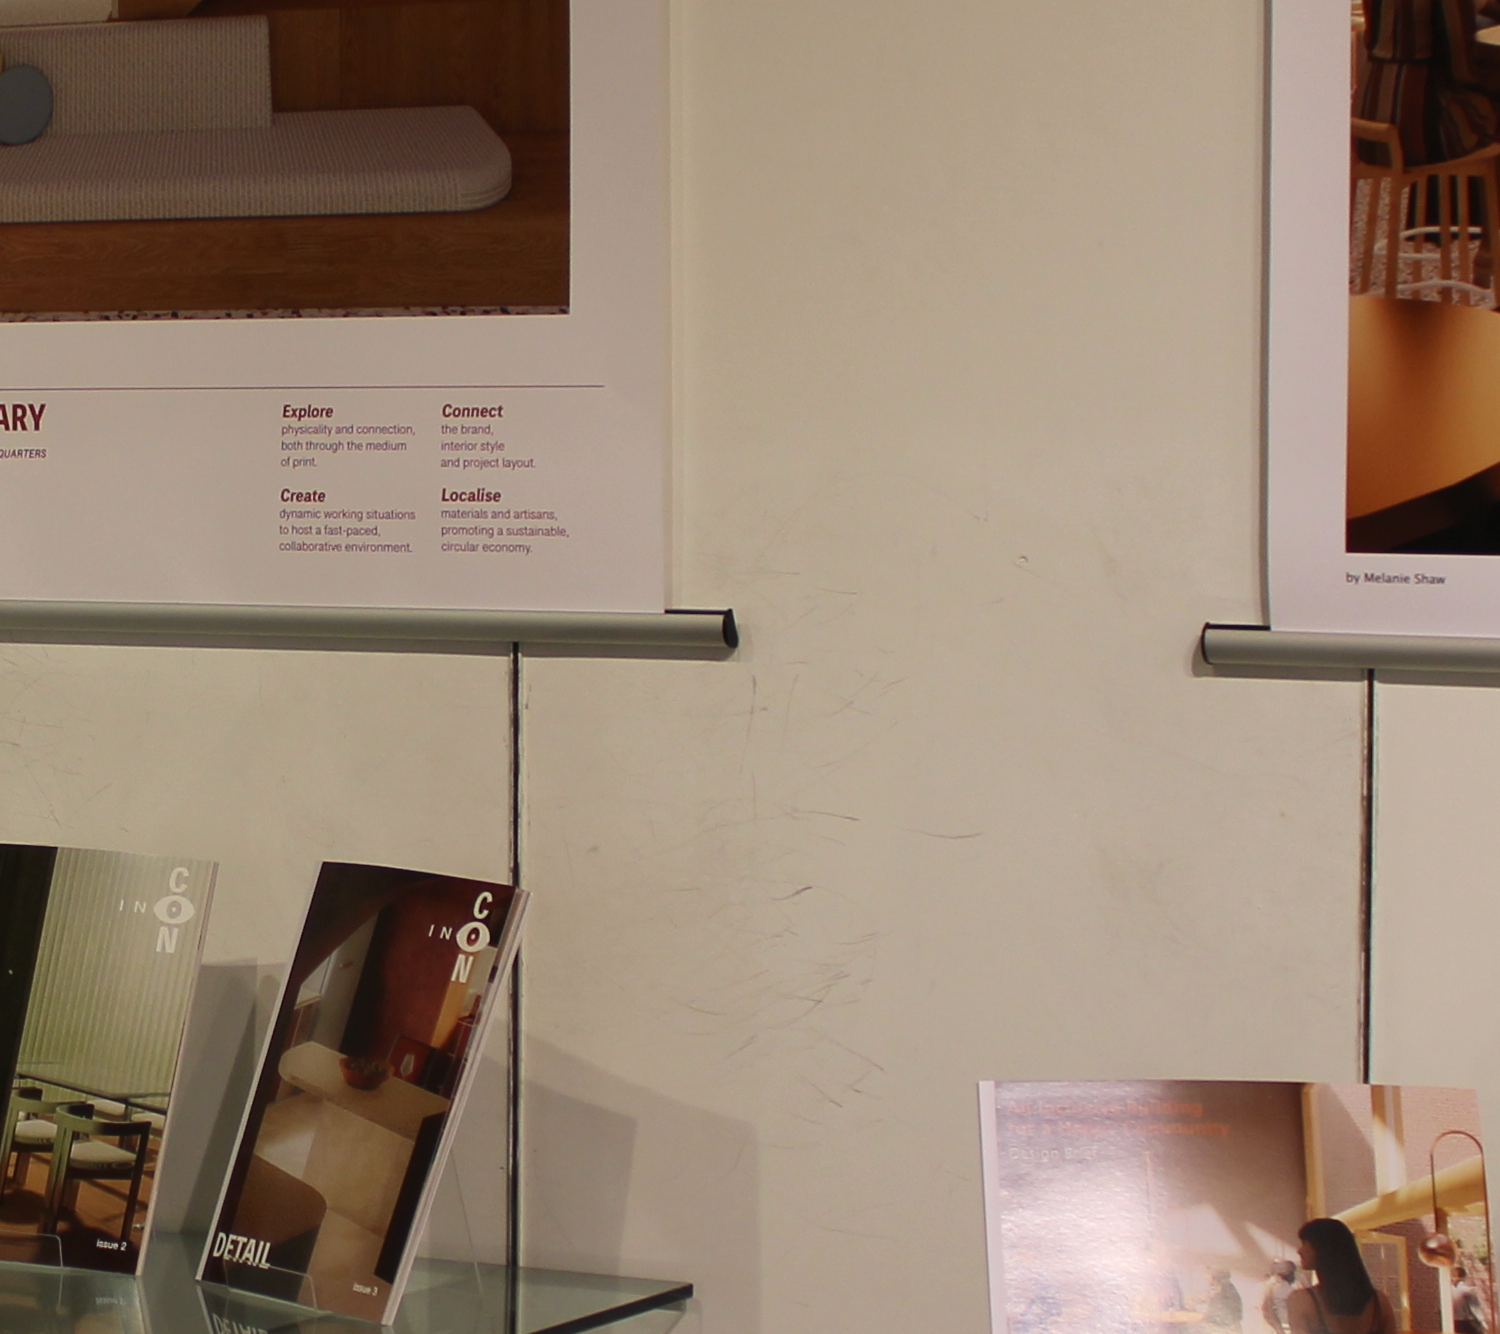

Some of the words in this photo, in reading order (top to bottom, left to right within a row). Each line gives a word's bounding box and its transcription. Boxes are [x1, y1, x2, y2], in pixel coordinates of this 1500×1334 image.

[283, 405, 334, 421] Explore
[442, 404, 503, 417] Connect
[282, 424, 332, 437] physicality
[335, 425, 354, 434] and
[356, 424, 415, 435] connection,
[441, 424, 458, 434] the
[461, 424, 494, 436] brand,
[282, 441, 303, 451] both
[306, 441, 344, 453] through
[347, 441, 363, 450] the
[366, 441, 407, 451] medium
[441, 441, 478, 451] interior
[481, 441, 505, 453] style
[281, 457, 290, 467] of
[293, 457, 317, 468] print.
[441, 458, 460, 467] and
[463, 458, 499, 470] project
[502, 458, 536, 470] layout.
[281, 489, 326, 502] Create
[442, 488, 501, 502] Localise
[280, 509, 321, 521] dynamic
[324, 509, 363, 522] working
[366, 509, 416, 520] situations
[441, 509, 488, 519] materials
[491, 509, 510, 519] and
[514, 509, 558, 521] artisans,
[280, 525, 289, 535] to
[292, 525, 313, 535] host
[316, 527, 321, 535] a
[324, 525, 381, 537] fast-paced,
[441, 525, 494, 538] promoting
[497, 528, 503, 536] a
[506, 526, 569, 538] sustainable,
[280, 541, 342, 551] collaborative
[345, 542, 412, 553] environment.
[441, 542, 479, 552] circular
[482, 542, 532, 555] economy.
[1346, 572, 1360, 585] by
[1364, 573, 1410, 584] Melanie
[1414, 574, 1446, 585] Shaw
[96, 1238, 118, 1250] issue
[120, 1241, 128, 1252] 2
[213, 1232, 271, 1269] DETAIL
[353, 1282, 372, 1295] issue
[372, 1287, 378, 1296] 3
